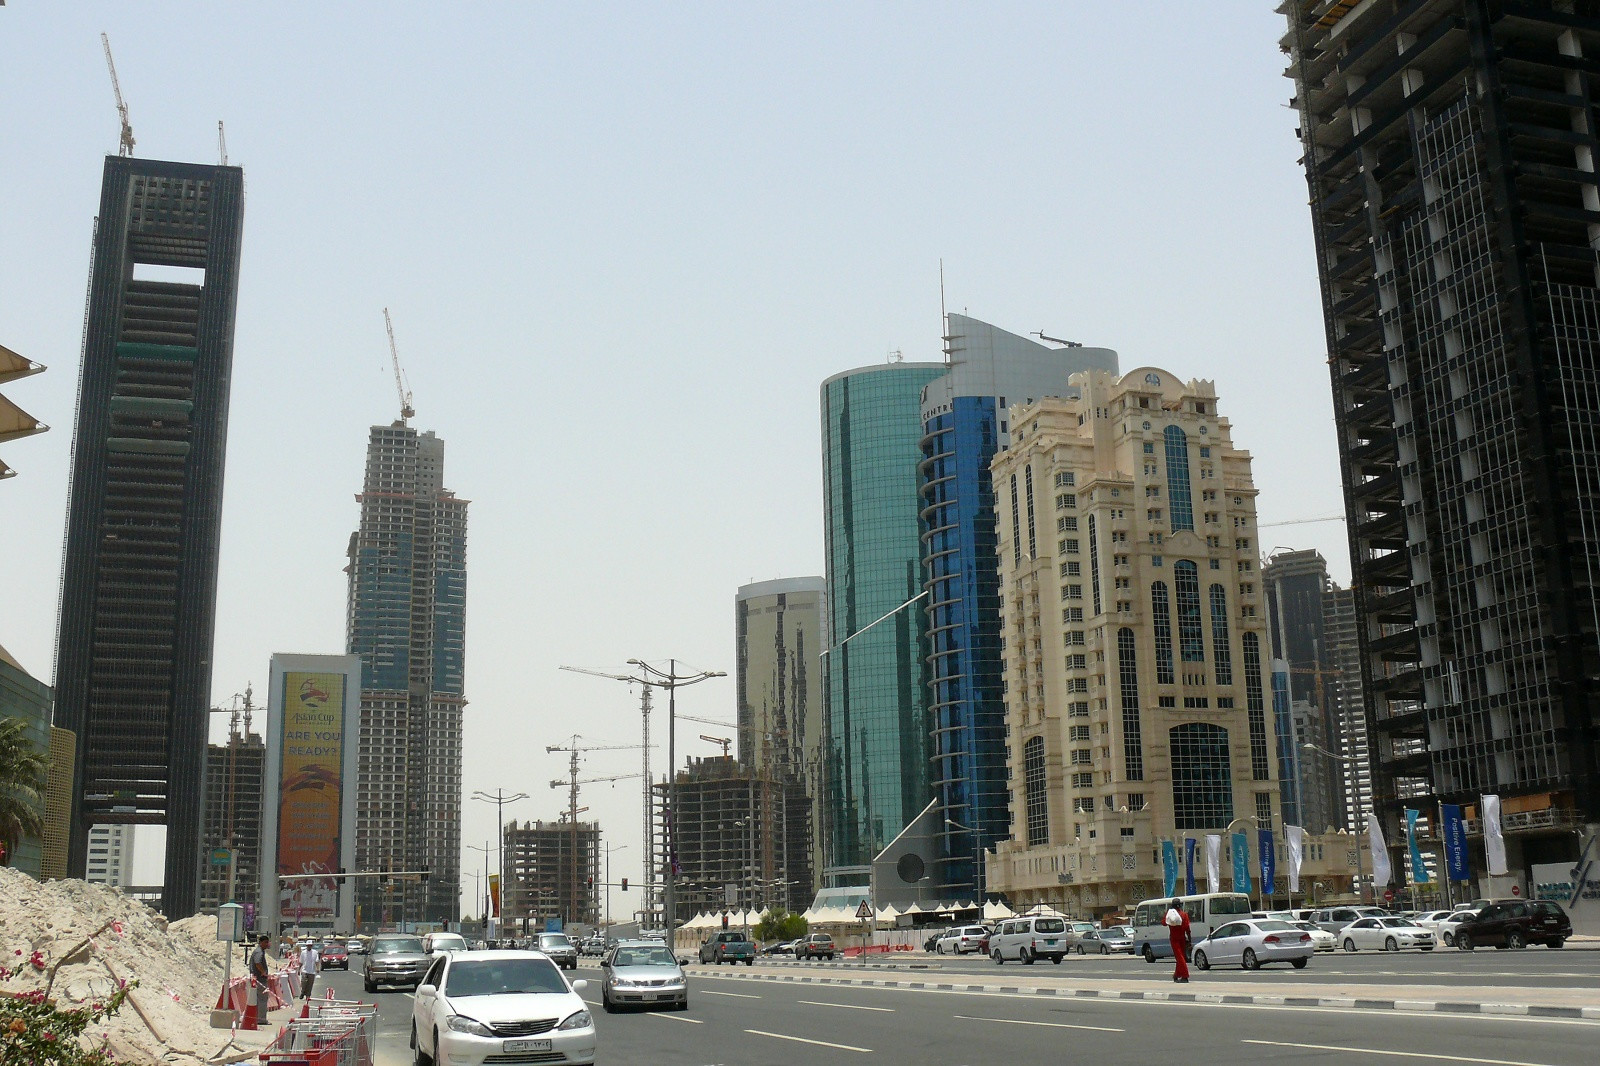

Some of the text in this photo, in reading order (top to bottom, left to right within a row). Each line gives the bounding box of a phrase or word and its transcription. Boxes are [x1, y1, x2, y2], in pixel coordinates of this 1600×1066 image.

[289, 712, 335, 725] Asian Cup
[286, 730, 341, 741] ARE YOU
[288, 746, 337, 756] READY?
[1451, 817, 1459, 846] Positive
